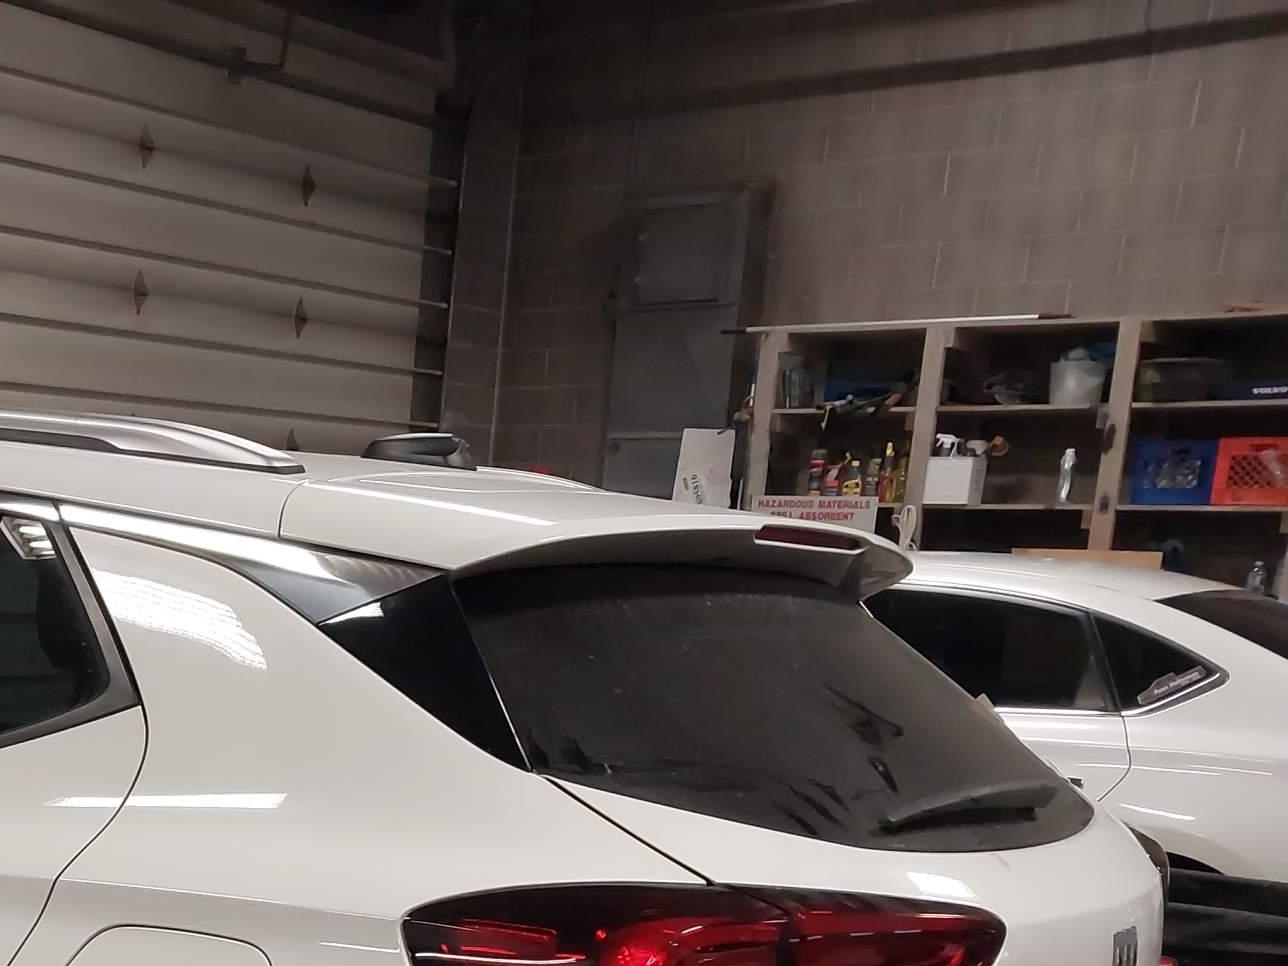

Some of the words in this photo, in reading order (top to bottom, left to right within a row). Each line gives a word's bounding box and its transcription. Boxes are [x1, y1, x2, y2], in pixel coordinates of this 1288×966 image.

[758, 499, 814, 509] HAZARDOUS
[818, 500, 871, 510] MATERIALS
[799, 511, 856, 521] ABSORBENT
